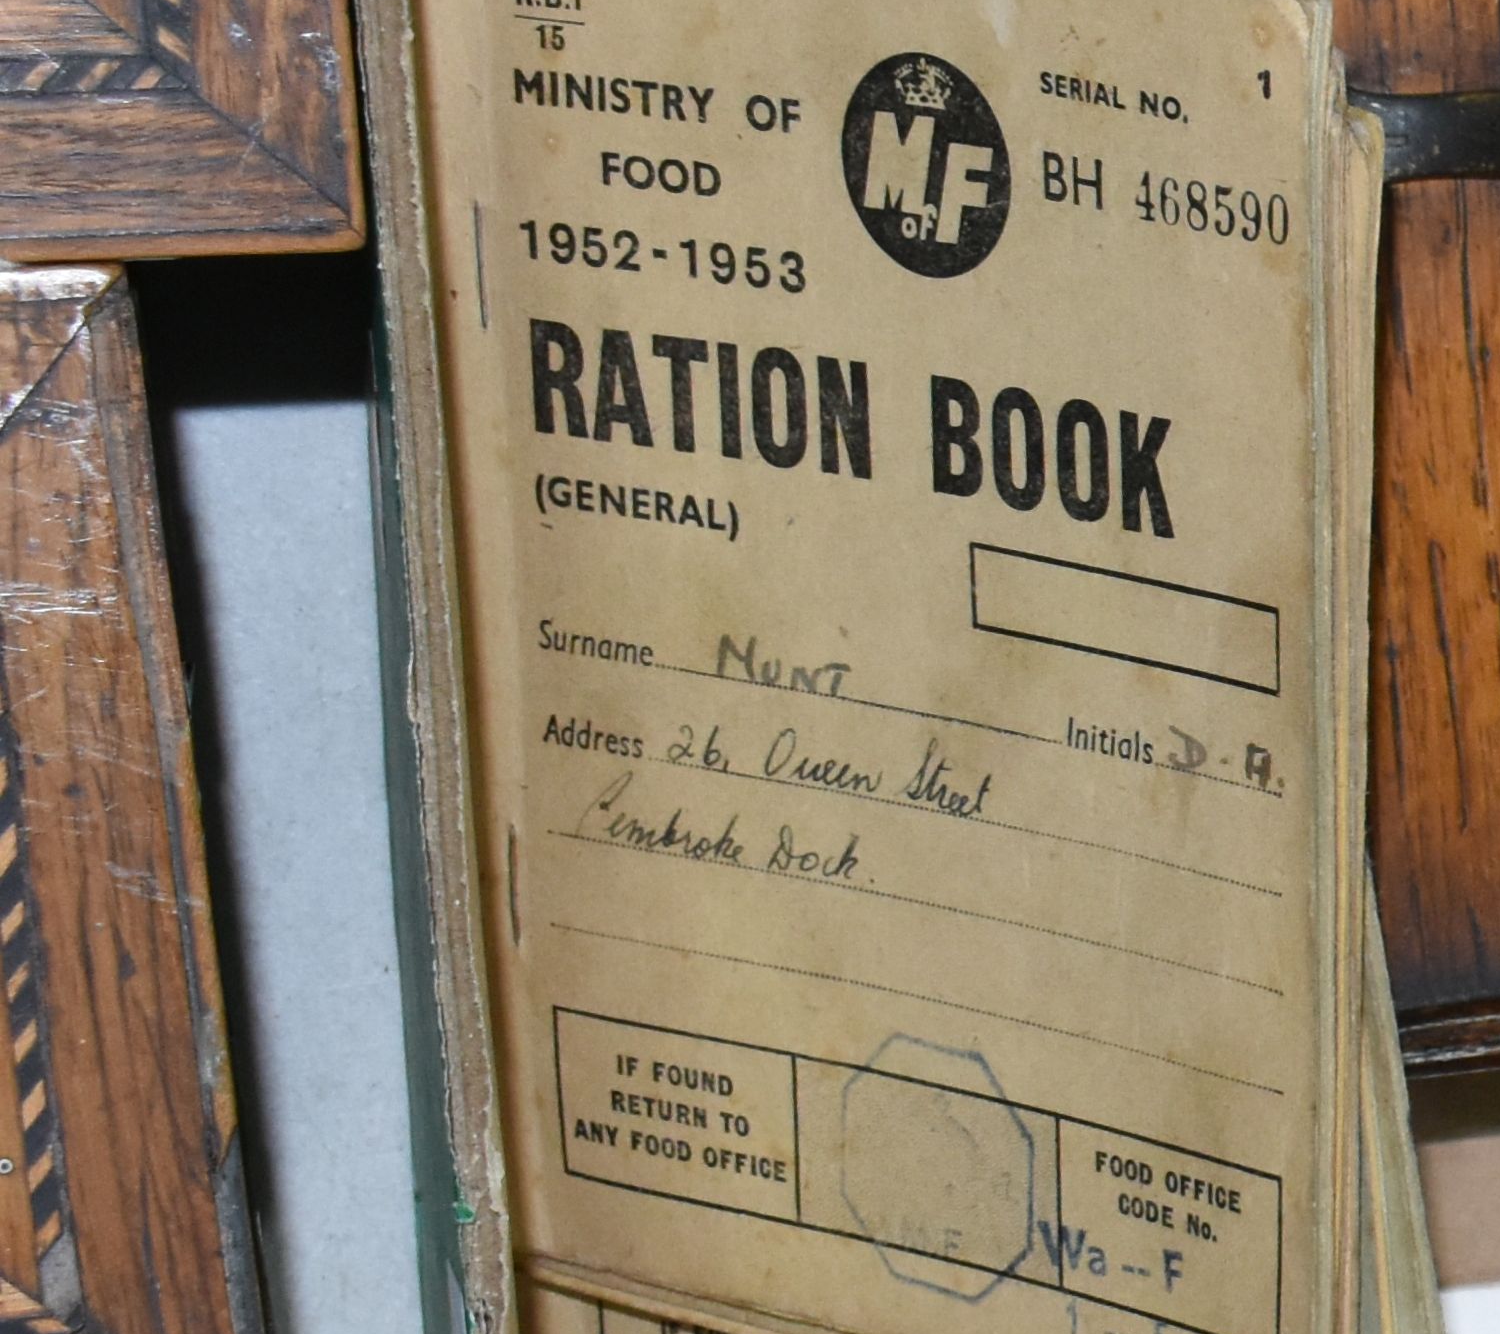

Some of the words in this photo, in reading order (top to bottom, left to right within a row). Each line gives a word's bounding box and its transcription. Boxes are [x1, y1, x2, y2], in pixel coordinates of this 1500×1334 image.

[535, 24, 565, 51] 15
[513, 70, 712, 124] MINISTRY
[746, 95, 801, 132] OF
[1039, 72, 1125, 110] SERIAL
[1139, 90, 1187, 122] NO.
[1258, 70, 1271, 100] 1
[600, 153, 720, 197] FOOD
[1042, 152, 1104, 210] BH
[1135, 171, 1289, 244] 468590
[520, 219, 807, 294] 1952-1953
[530, 319, 872, 480] RATION
[931, 375, 1174, 538] BOOK
[535, 475, 738, 540] (GENERAL)
[539, 620, 654, 668] Surname
[542, 715, 644, 760] Address
[1066, 717, 1153, 766] Initials
[906, 740, 991, 819] Street
[616, 1053, 640, 1077] IF
[651, 1060, 733, 1098] FOUND
[610, 1091, 708, 1128] RETURN
[719, 1110, 749, 1138] TO
[574, 1119, 618, 1148] ANY
[631, 1131, 691, 1164] FOOD
[703, 1145, 787, 1184] OFFICE
[1095, 1151, 1151, 1185] FOOD
[1166, 1170, 1240, 1214] OFFICE
[1118, 1193, 1173, 1229] CODE
[1187, 1214, 1218, 1243] No.
[1037, 1221, 1107, 1277] Wa
[1164, 1250, 1184, 1293] F
